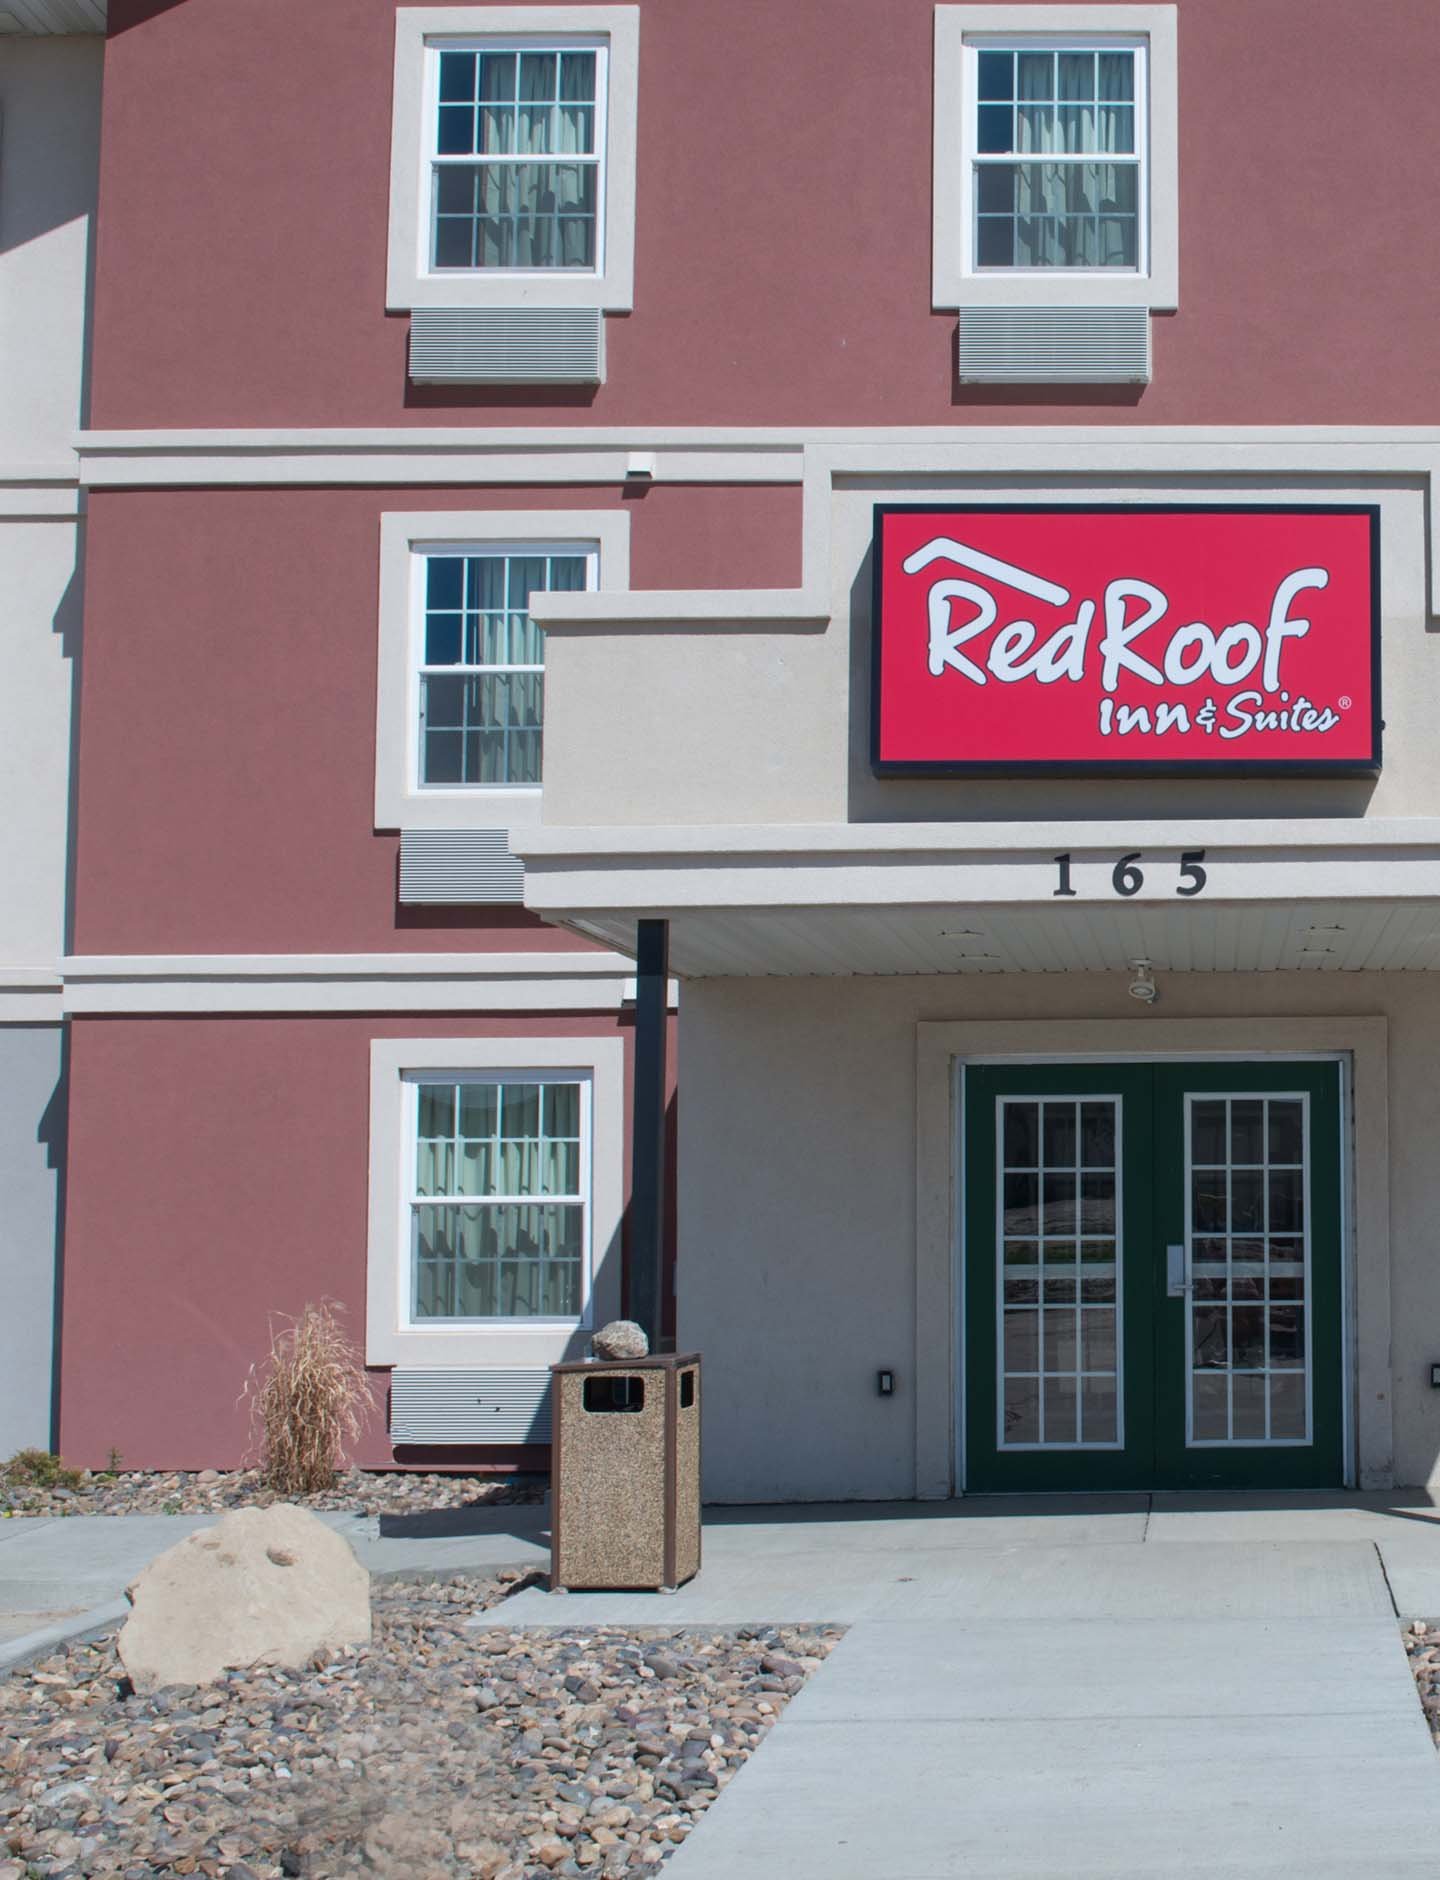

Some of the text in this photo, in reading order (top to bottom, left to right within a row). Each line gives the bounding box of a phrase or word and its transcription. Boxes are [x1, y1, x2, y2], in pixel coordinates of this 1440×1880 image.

[1099, 698, 1191, 736] Inn
[1196, 697, 1217, 735] &
[1053, 849, 1207, 897] 165
